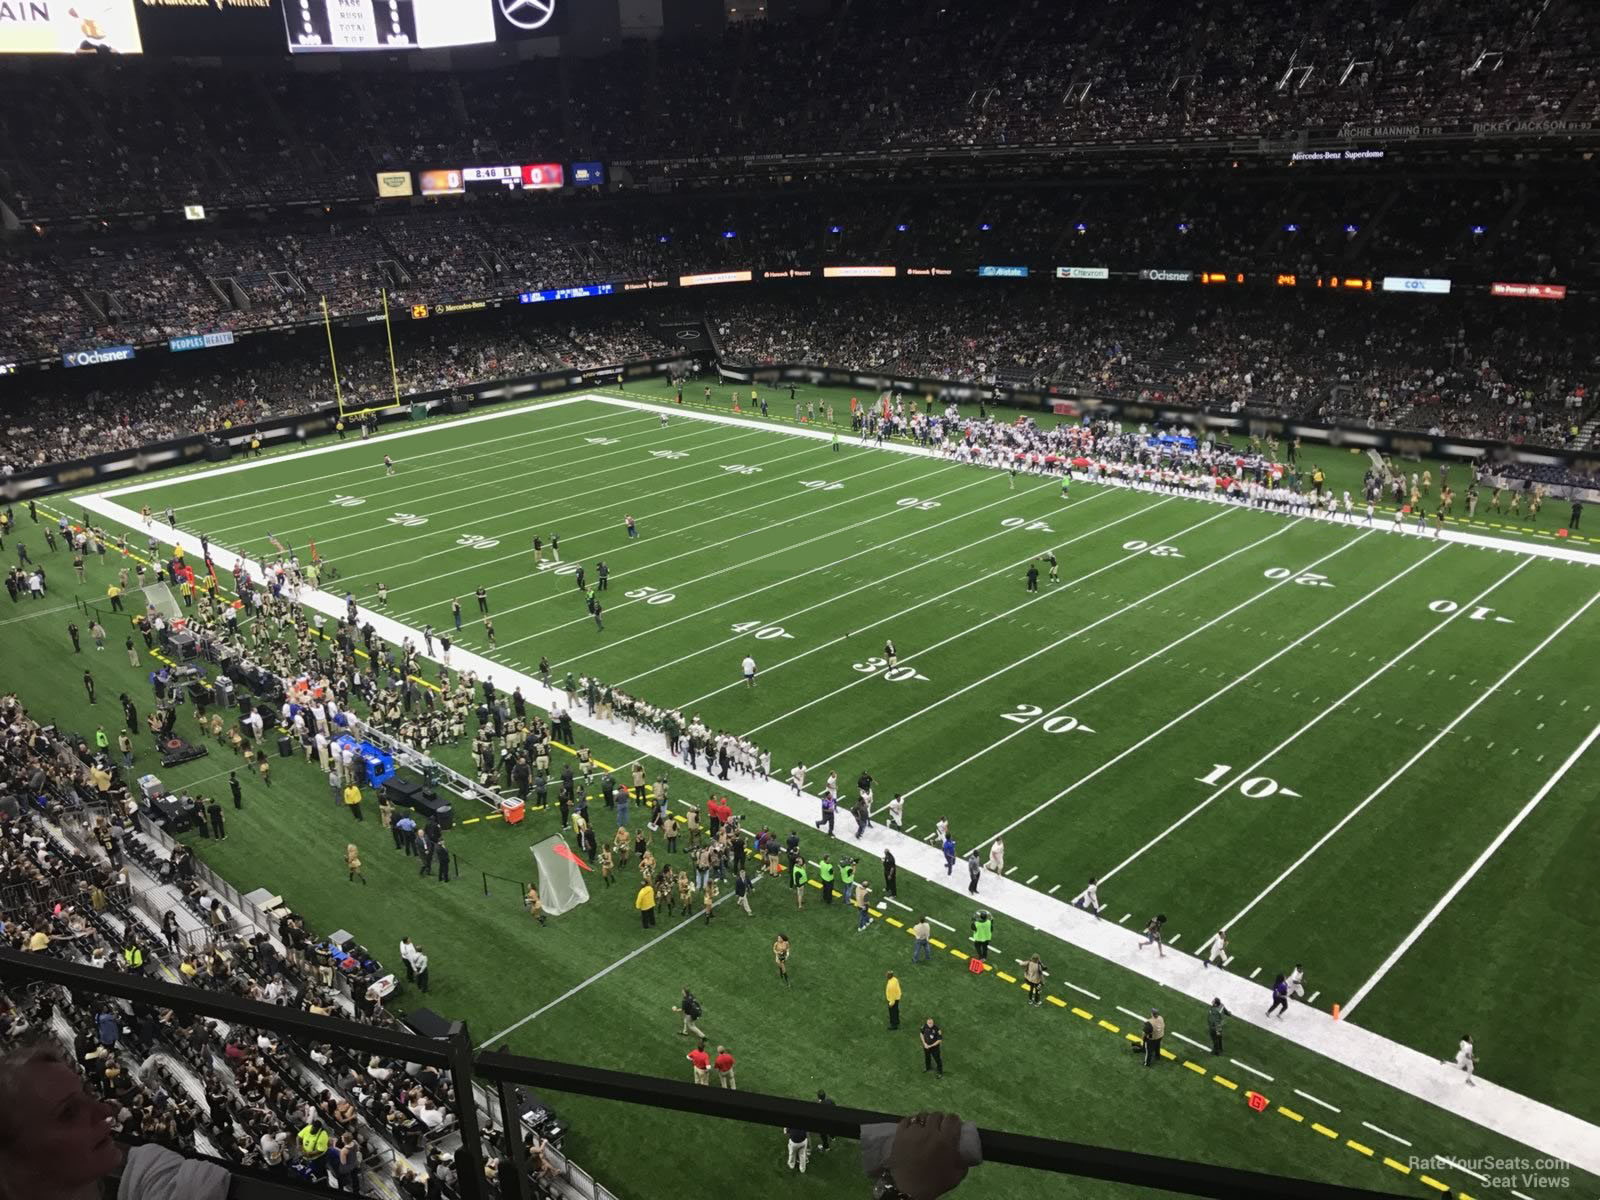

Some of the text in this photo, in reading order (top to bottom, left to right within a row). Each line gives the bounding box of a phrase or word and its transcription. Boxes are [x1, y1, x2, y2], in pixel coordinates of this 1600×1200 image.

[1337, 127, 1372, 139] ARCHIE
[1374, 125, 1420, 137] MANNING
[1473, 121, 1511, 132] RICKEY
[1514, 120, 1567, 131] JACKSON
[1292, 150, 1384, 161] Mercedes-Benz Superdome
[1073, 269, 1104, 277] Chevron
[1149, 269, 1189, 281] Ochsner
[413, 305, 427, 318] 25
[171, 338, 203, 350] PEOPLES
[77, 349, 129, 366] Ochsner
[896, 497, 941, 511] 50
[456, 533, 500, 550] 30
[1122, 540, 1180, 558] 30
[624, 586, 676, 605] 50
[731, 620, 785, 640] 40
[853, 656, 918, 682] 30
[1000, 704, 1078, 734] 20
[1194, 763, 1279, 798] 10
[1252, 1095, 1262, 1109] G
